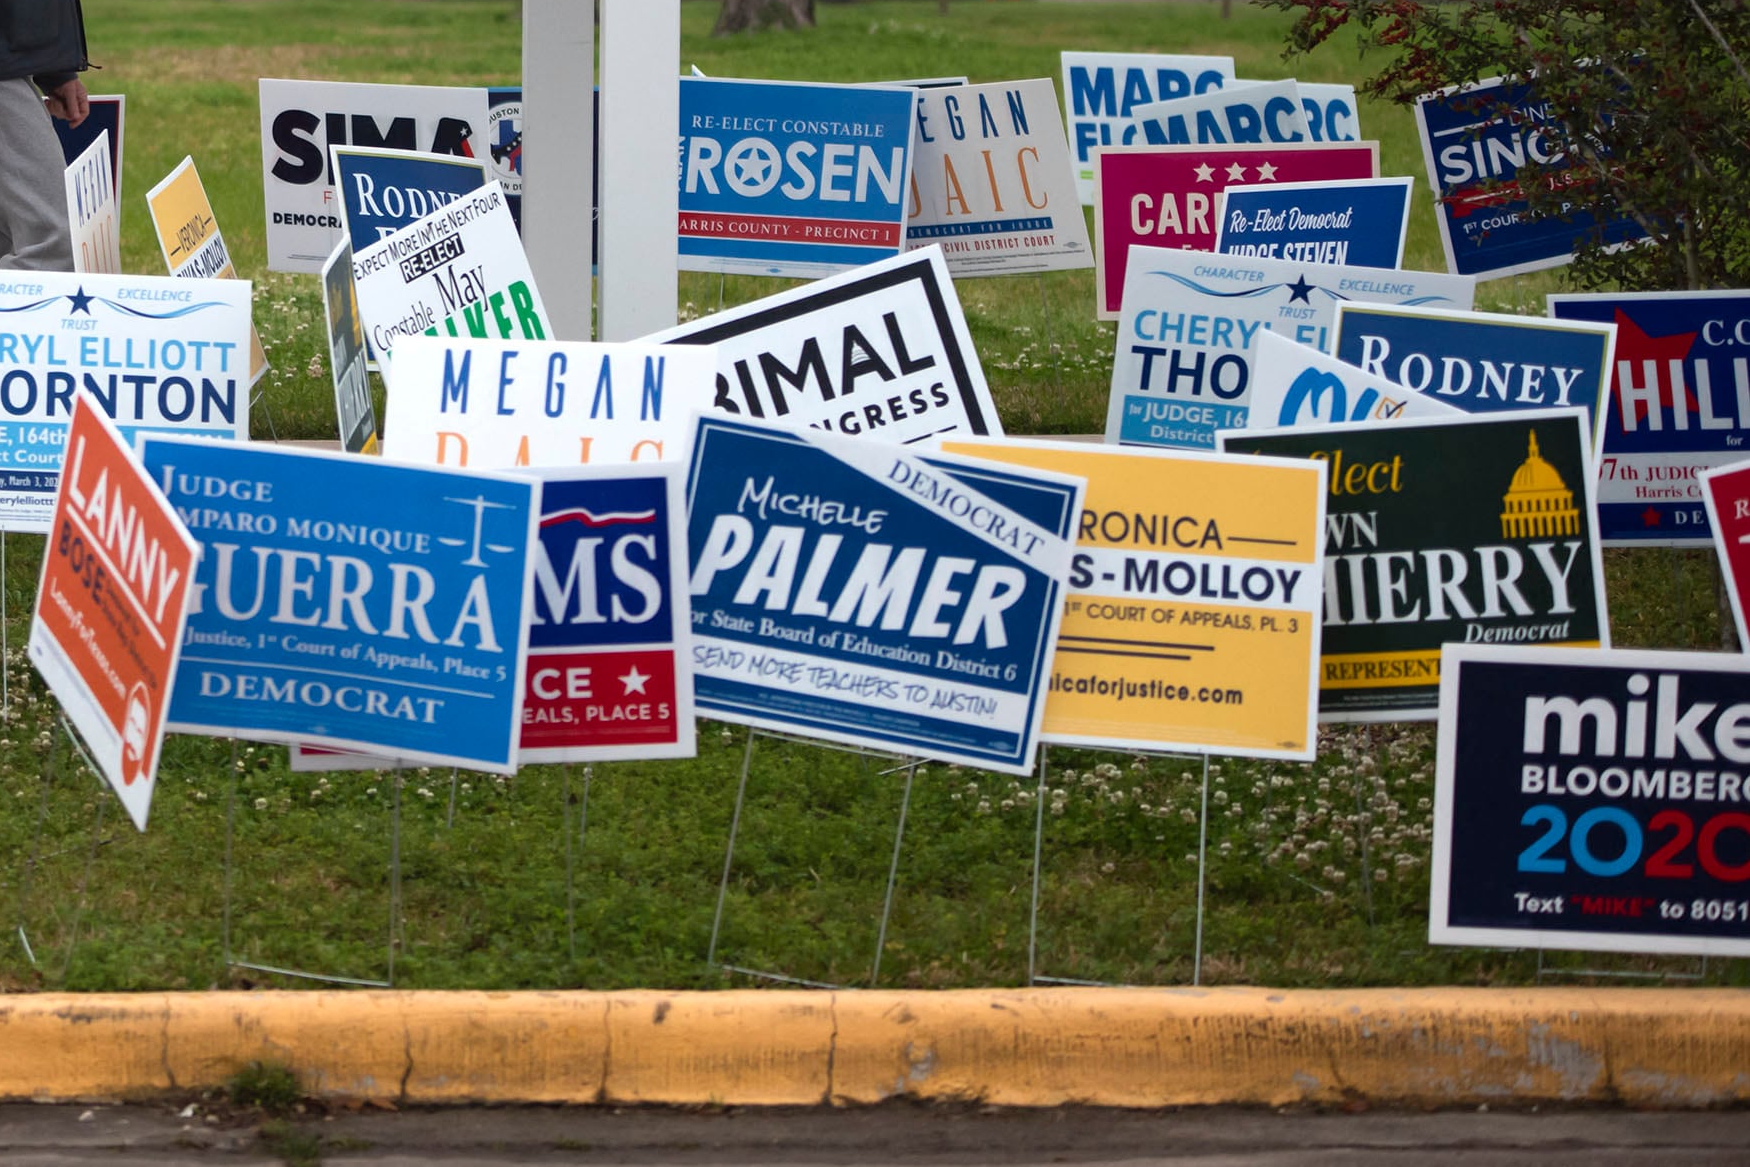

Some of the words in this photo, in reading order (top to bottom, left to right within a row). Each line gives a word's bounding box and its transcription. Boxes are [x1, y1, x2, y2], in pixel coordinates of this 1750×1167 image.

[692, 115, 777, 132] RE-ELECT
[781, 119, 885, 138] CONSTABLE
[1142, 96, 1303, 145] MARC
[685, 136, 904, 205] ROSEN
[728, 221, 791, 236] COUNTY
[804, 225, 880, 241] PRECINCT
[908, 224, 972, 238] DEMOCRAT
[979, 222, 1003, 233] FOR
[1011, 219, 1049, 230] JUDGE
[1230, 208, 1285, 233] Re-Elect
[1288, 206, 1354, 231] Democrat
[401, 235, 464, 282] RE-ELECT
[944, 239, 971, 253] CIVIL
[974, 237, 1020, 252] DISTRICT
[1024, 235, 1056, 247] COURT
[1283, 241, 1349, 266] STEVEN
[117, 287, 192, 302] EXCELLENCE
[433, 265, 489, 316] May
[1193, 266, 1264, 283] CHARACTER
[1339, 278, 1415, 296] EXCELLENCE
[61, 318, 98, 331] TRUST
[1278, 306, 1317, 320] TRUST
[80, 336, 236, 373] ELLIOTT
[440, 348, 665, 422] MEGAN
[1359, 334, 1584, 407] RODNEY
[1143, 401, 1220, 427] JUDGE,
[17, 425, 68, 446] 164th
[1150, 425, 1214, 444] District
[1726, 434, 1743, 447] for
[14, 449, 64, 464] Court
[9, 475, 31, 486] March
[1635, 486, 1682, 499] Harris
[886, 459, 1045, 556] DEMOCRAT
[69, 436, 180, 624] LANNY
[286, 517, 431, 555] MONIQUE
[58, 517, 105, 605] BOSE
[690, 514, 1028, 650] PALMER
[1086, 603, 1146, 624] COURT
[1151, 607, 1175, 624] OF
[1180, 610, 1256, 632] APPEALS,
[1259, 615, 1286, 633] PL.
[1286, 617, 1299, 634] 3
[1464, 619, 1569, 644] Democrat
[183, 626, 252, 649] Justice,
[281, 636, 336, 658] Court
[340, 643, 360, 660] of
[363, 649, 439, 674] Appeals,
[443, 657, 490, 680] Place
[495, 665, 507, 682] 5
[710, 610, 755, 634] State
[758, 618, 814, 647] Board
[817, 630, 839, 649] of
[840, 634, 931, 666] Education
[935, 651, 1001, 680] District
[1003, 664, 1018, 682] 6
[693, 645, 744, 672] SEND
[748, 653, 805, 685] MORE
[807, 666, 899, 701] TEACHERS
[903, 683, 930, 704] TO
[199, 671, 445, 724] DEMOCRAT
[585, 703, 650, 722] PLACE
[658, 702, 670, 720] 5
[1523, 673, 1750, 764] mike
[1517, 804, 1750, 882] 2020
[1514, 892, 1564, 913] Text
[1570, 895, 1656, 918] "MIKE"
[1659, 899, 1684, 919] to
